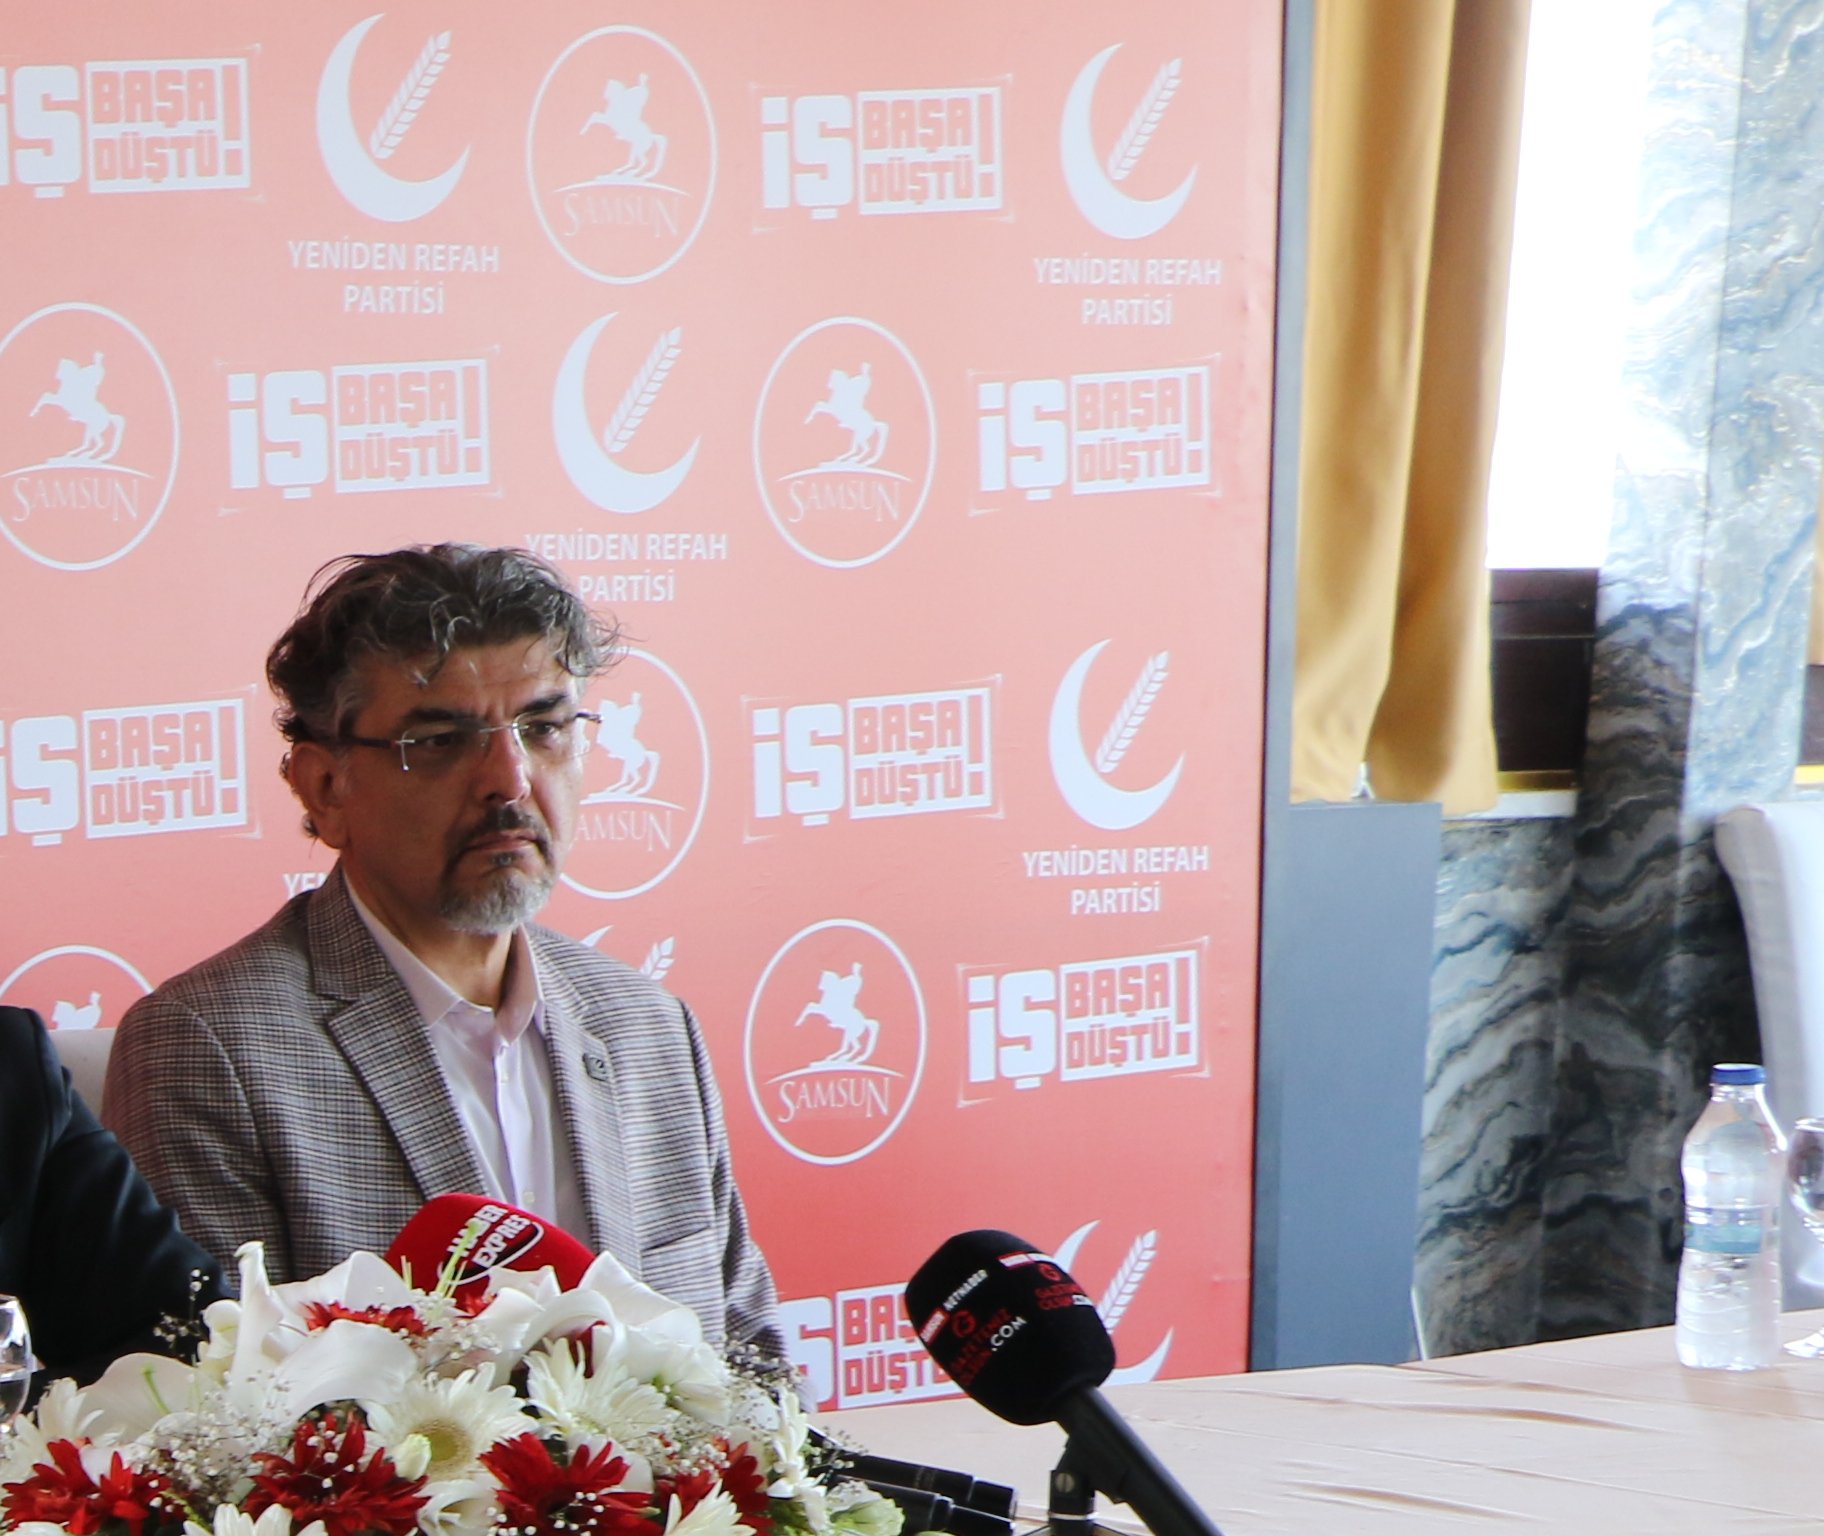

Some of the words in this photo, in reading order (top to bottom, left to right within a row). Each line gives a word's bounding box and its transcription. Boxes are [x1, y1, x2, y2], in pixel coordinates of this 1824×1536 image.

[91, 69, 216, 128] BAŞA
[863, 97, 972, 153] BAŞA
[762, 95, 853, 219] İŞ
[563, 192, 680, 239] SAMSUN
[288, 236, 407, 270] YENİDEN
[415, 244, 499, 272] REFAH
[1034, 253, 1139, 284] YENİDEN
[1146, 259, 1222, 284] REFAH
[345, 281, 444, 314] PARTİSİ
[1083, 294, 1172, 325] PARTİSİ
[338, 370, 457, 428] BAŞA
[1077, 377, 1181, 432] BAŞA
[228, 370, 328, 498] İŞ
[980, 379, 1067, 500] İŞ
[13, 477, 139, 522] SAMSUN
[788, 480, 901, 523] SAMSUN
[525, 528, 638, 560] YENİDEN
[647, 534, 727, 560] REFAH
[579, 569, 674, 601] PARTİSİ
[89, 711, 212, 770] BAŞA
[854, 700, 961, 755] BAŞA
[753, 704, 844, 825] İŞ
[568, 809, 673, 852] AMSUN
[1023, 845, 1128, 877] YENİDEN
[1134, 846, 1209, 873] REFAH
[1072, 881, 1161, 914] PARTİSİ
[1066, 963, 1169, 1019] BAŞA
[969, 969, 1056, 1088] İŞ
[778, 1077, 891, 1125] SAMSUN
